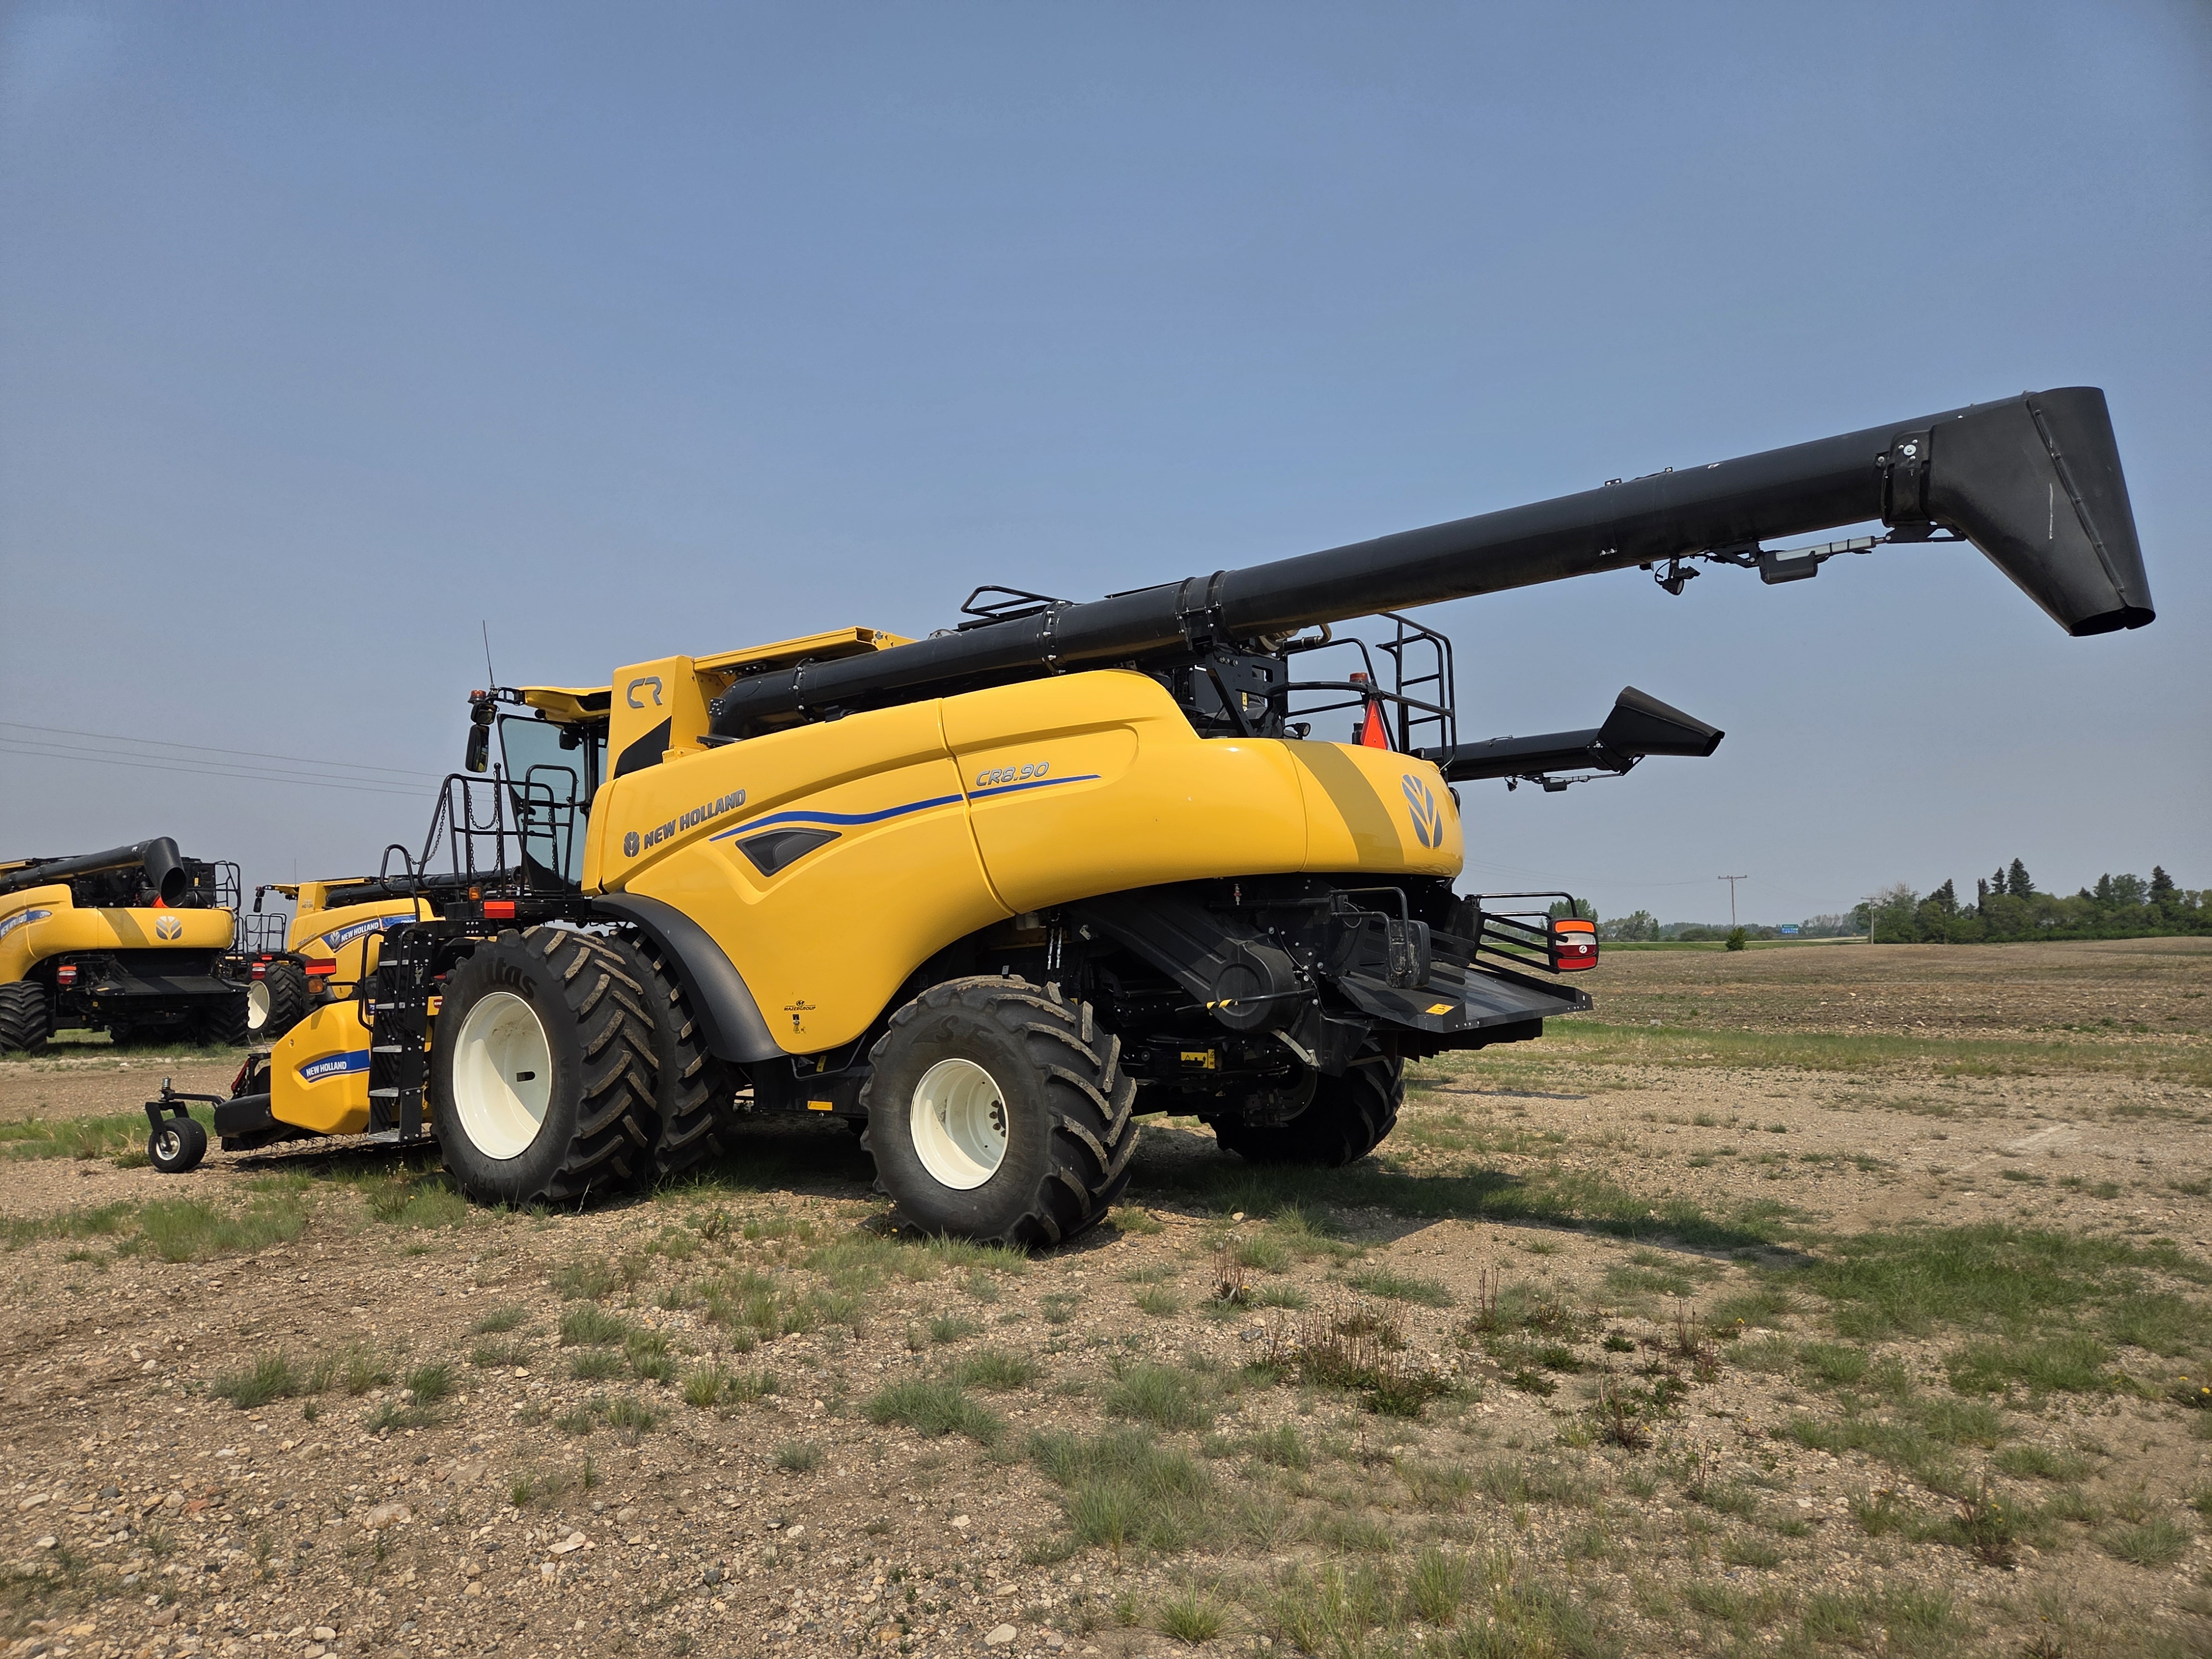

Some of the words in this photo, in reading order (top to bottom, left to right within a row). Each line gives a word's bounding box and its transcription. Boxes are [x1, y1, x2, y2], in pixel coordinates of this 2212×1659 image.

[627, 676, 663, 709] CR
[976, 761, 1050, 786] CR8.90
[644, 819, 676, 850] NEW
[680, 789, 746, 832] HOLLAND
[341, 930, 353, 942] NEW
[354, 922, 379, 935] HOLLAND
[306, 1065, 319, 1077] NEW
[320, 1061, 347, 1073] HOLLAND
